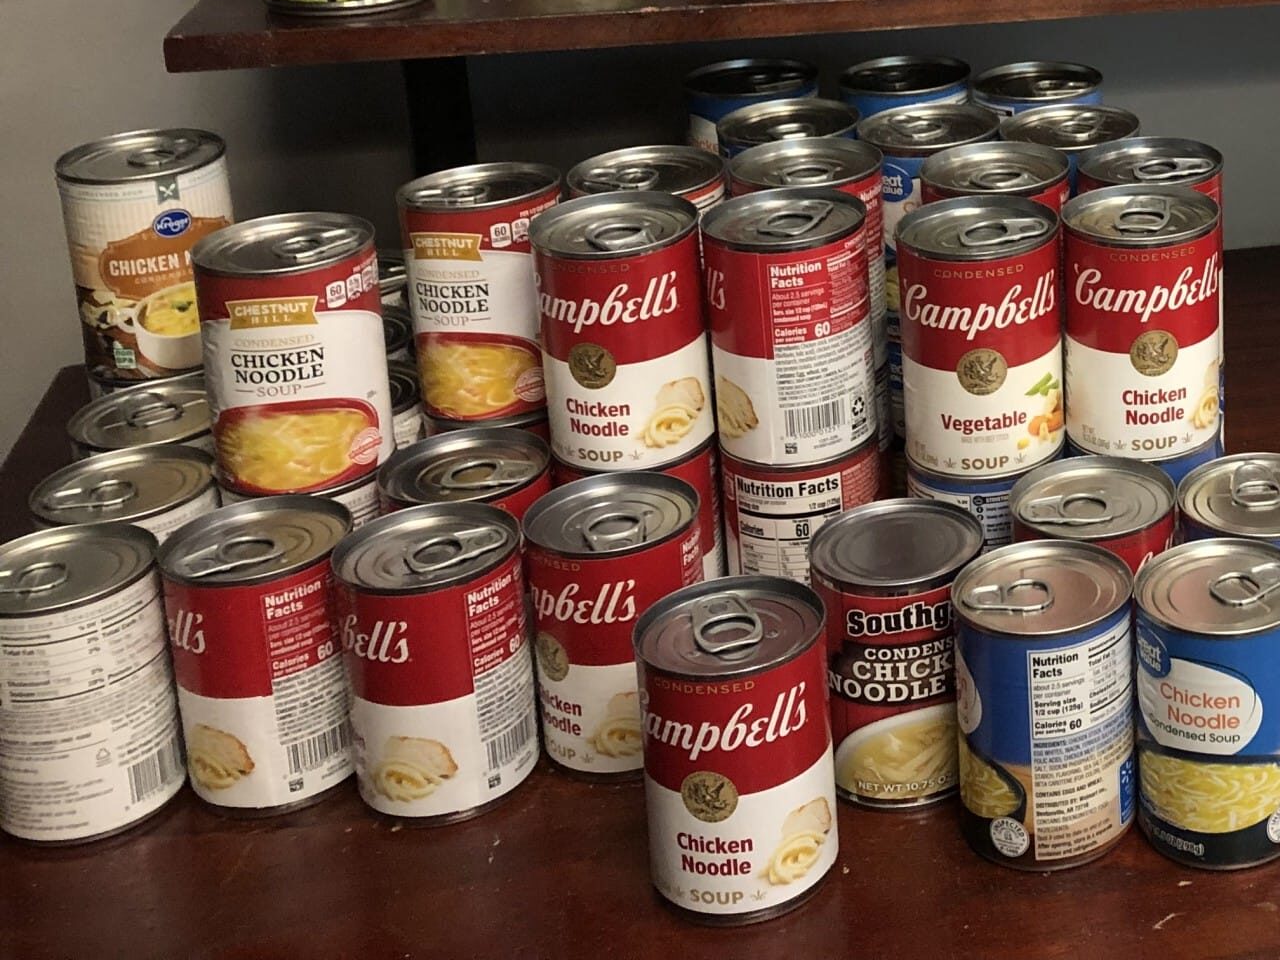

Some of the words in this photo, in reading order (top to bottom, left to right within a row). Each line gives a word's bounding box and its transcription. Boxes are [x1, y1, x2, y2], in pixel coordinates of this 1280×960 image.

[156, 216, 188, 233] Kroger
[415, 238, 473, 249] CHESTNUT
[1109, 247, 1197, 262] CONDENSED
[109, 254, 179, 277] CHICKEN
[770, 261, 822, 277] Nutrition
[933, 263, 1025, 280] CONDENSED
[416, 283, 490, 298] CHICKEN
[771, 277, 804, 289] Facts
[1074, 252, 1219, 323] Campbell's
[234, 303, 309, 318] CHESTNUT
[419, 298, 489, 313] NOODLE
[540, 270, 679, 334] ampbell's
[903, 269, 1055, 340] Campbell's
[434, 315, 469, 327] SOUP
[775, 328, 807, 337] Calories
[815, 321, 831, 338] 60
[230, 347, 325, 370] CHICKEN
[234, 363, 325, 384] NOODLE
[256, 384, 302, 398] SOUP
[1122, 387, 1187, 407] Chicken
[566, 398, 631, 417] Chicken
[1125, 406, 1185, 426] Noodle
[570, 417, 630, 437] Noodle
[941, 410, 1028, 435] Vegetable
[1131, 436, 1179, 452] SOUP
[578, 448, 623, 462] SOUP
[961, 455, 1010, 470] SOUP
[736, 477, 794, 498] Nutrition
[799, 477, 839, 497] Facts
[795, 523, 810, 537] 60
[264, 580, 322, 608] Nutrition
[467, 574, 512, 605] Nutrition
[266, 600, 304, 620] Facts
[468, 595, 500, 617] Facts
[847, 601, 954, 637] Southg
[272, 653, 310, 671] Calories
[317, 640, 334, 660] 60
[474, 647, 505, 668] Calories
[509, 634, 521, 653] 60
[864, 637, 953, 661] CONDENS
[852, 652, 951, 681] CHICK
[1032, 652, 1079, 668] Nutrition
[1033, 665, 1063, 679] Facts
[655, 678, 755, 695] CONDENSED
[828, 674, 946, 702] NOODLE
[1160, 682, 1241, 709] Chicken
[1034, 720, 1067, 730] Calories
[1069, 718, 1082, 730] 60
[1167, 704, 1241, 730] Noodle
[1209, 732, 1241, 744] Soup
[676, 832, 753, 854] Chicken
[682, 857, 752, 877] Noodle
[690, 889, 744, 906] SOUP
